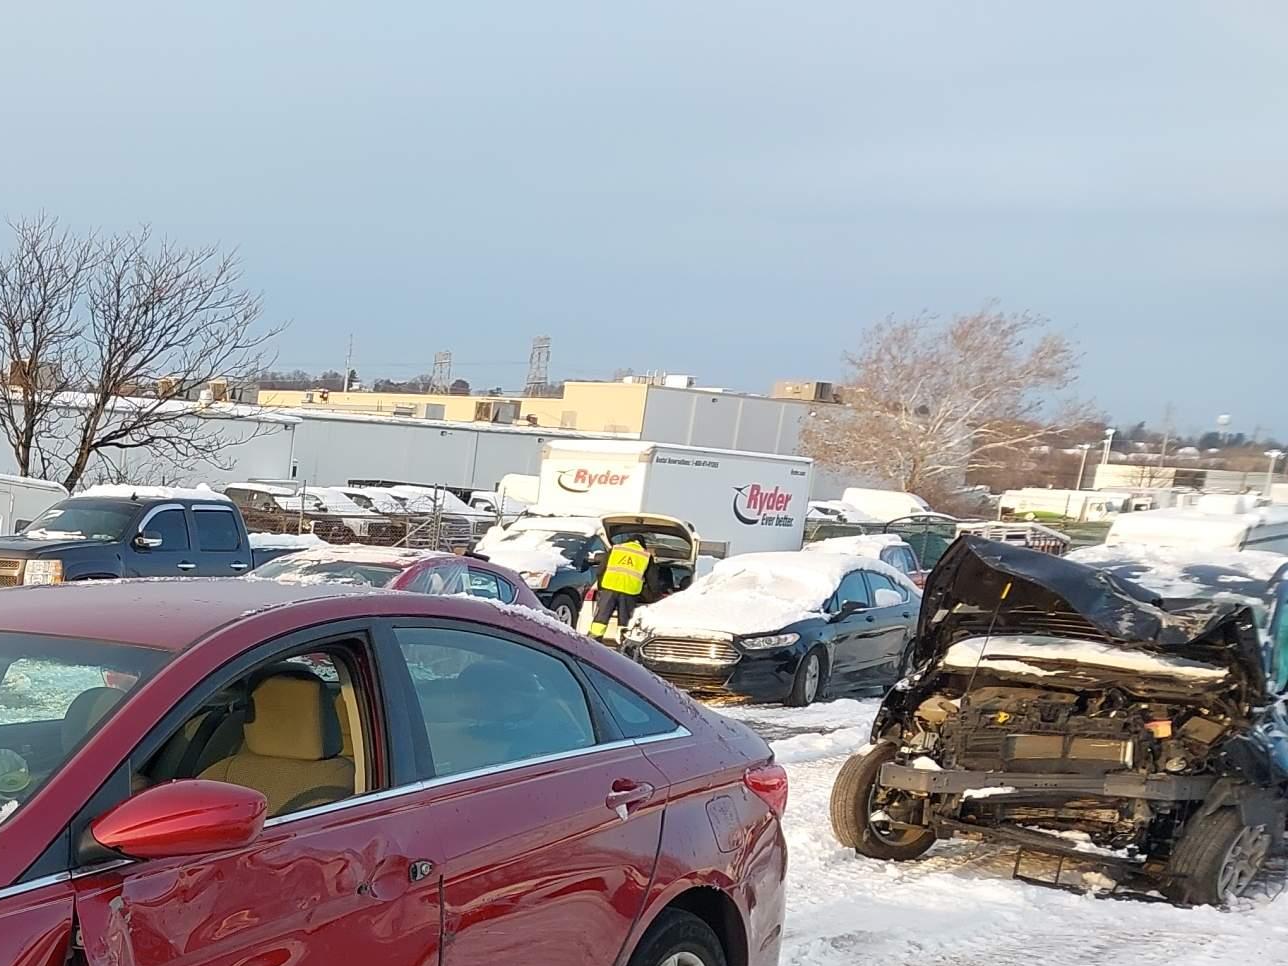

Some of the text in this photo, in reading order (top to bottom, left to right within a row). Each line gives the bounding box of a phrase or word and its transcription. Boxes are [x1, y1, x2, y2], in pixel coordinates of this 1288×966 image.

[573, 468, 630, 488] Ryder
[746, 484, 793, 516] Ryder
[761, 513, 776, 526] Ever
